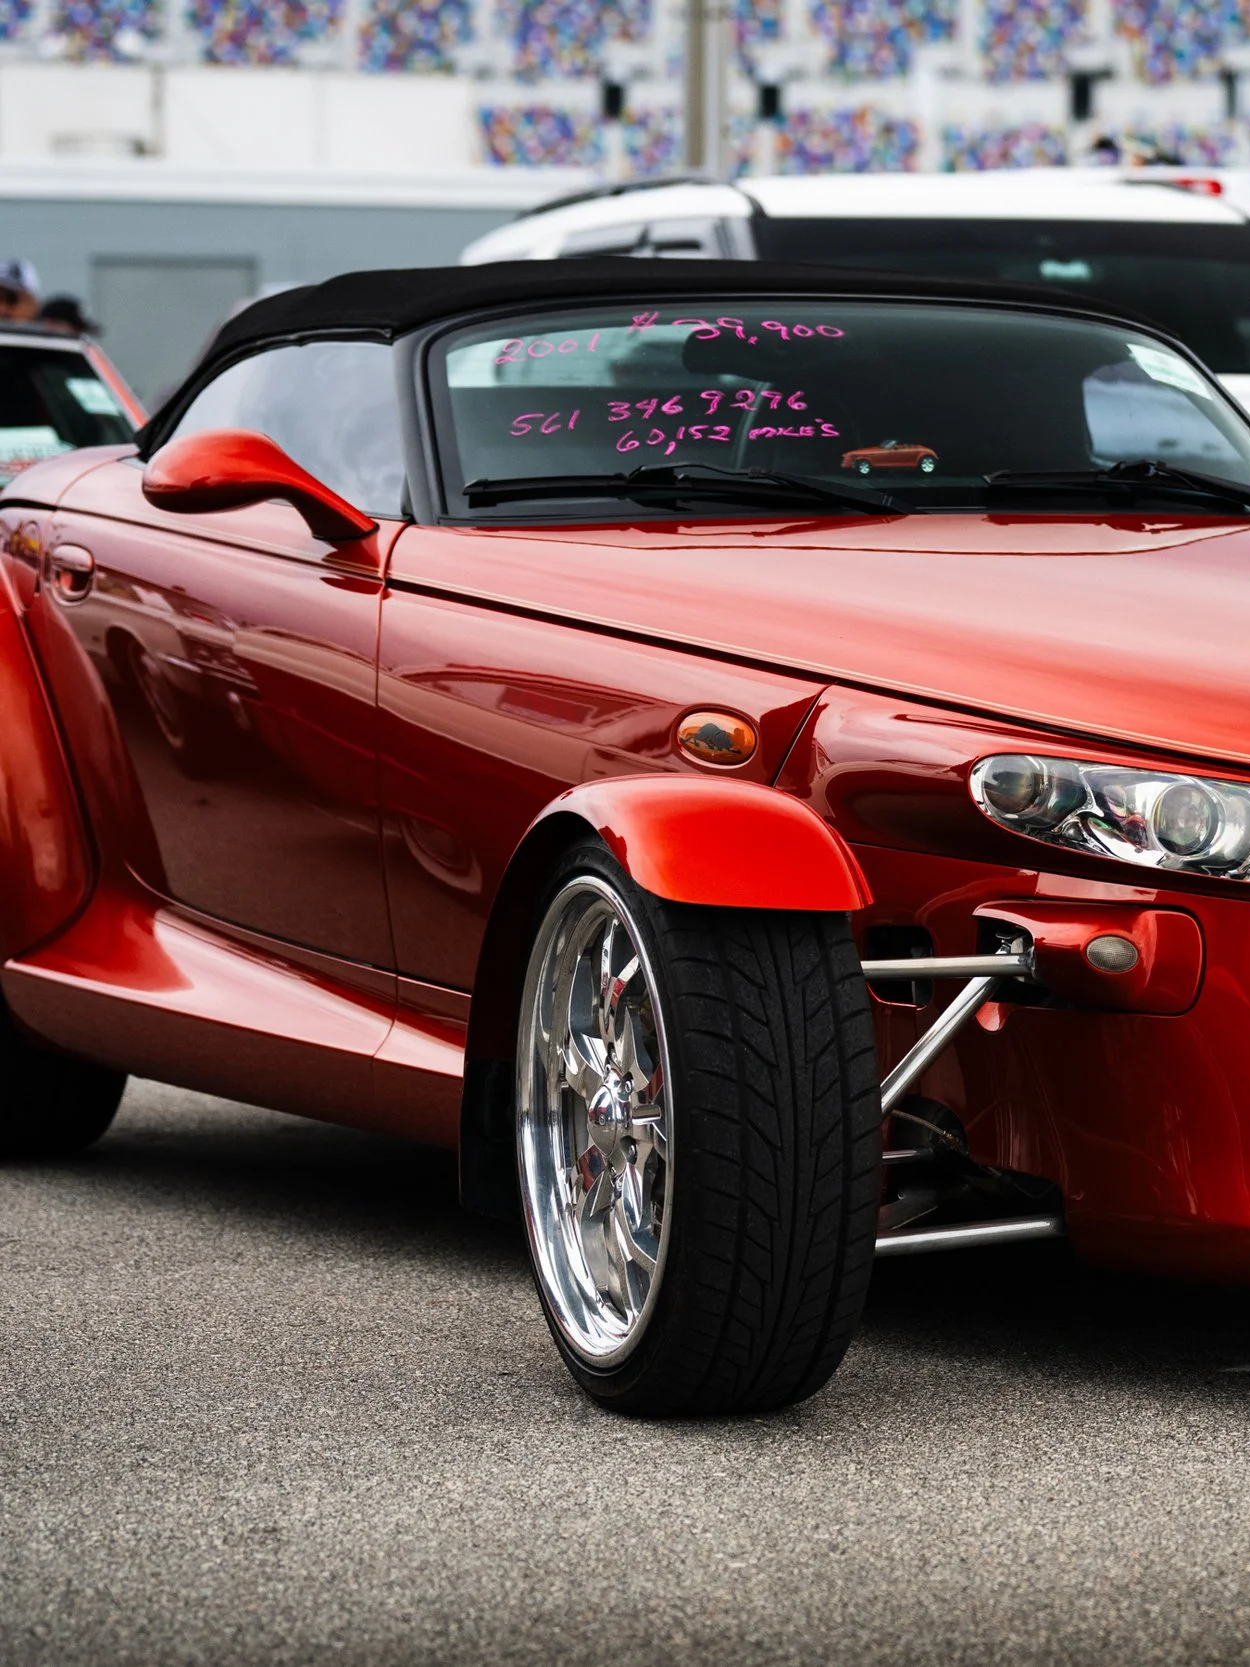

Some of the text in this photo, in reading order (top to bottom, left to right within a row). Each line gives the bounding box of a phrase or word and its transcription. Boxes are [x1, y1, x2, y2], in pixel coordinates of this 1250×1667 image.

[495, 332, 600, 365] 2001
[510, 409, 581, 436] 561
[607, 395, 684, 422] 346
[616, 424, 731, 456] 60,152
